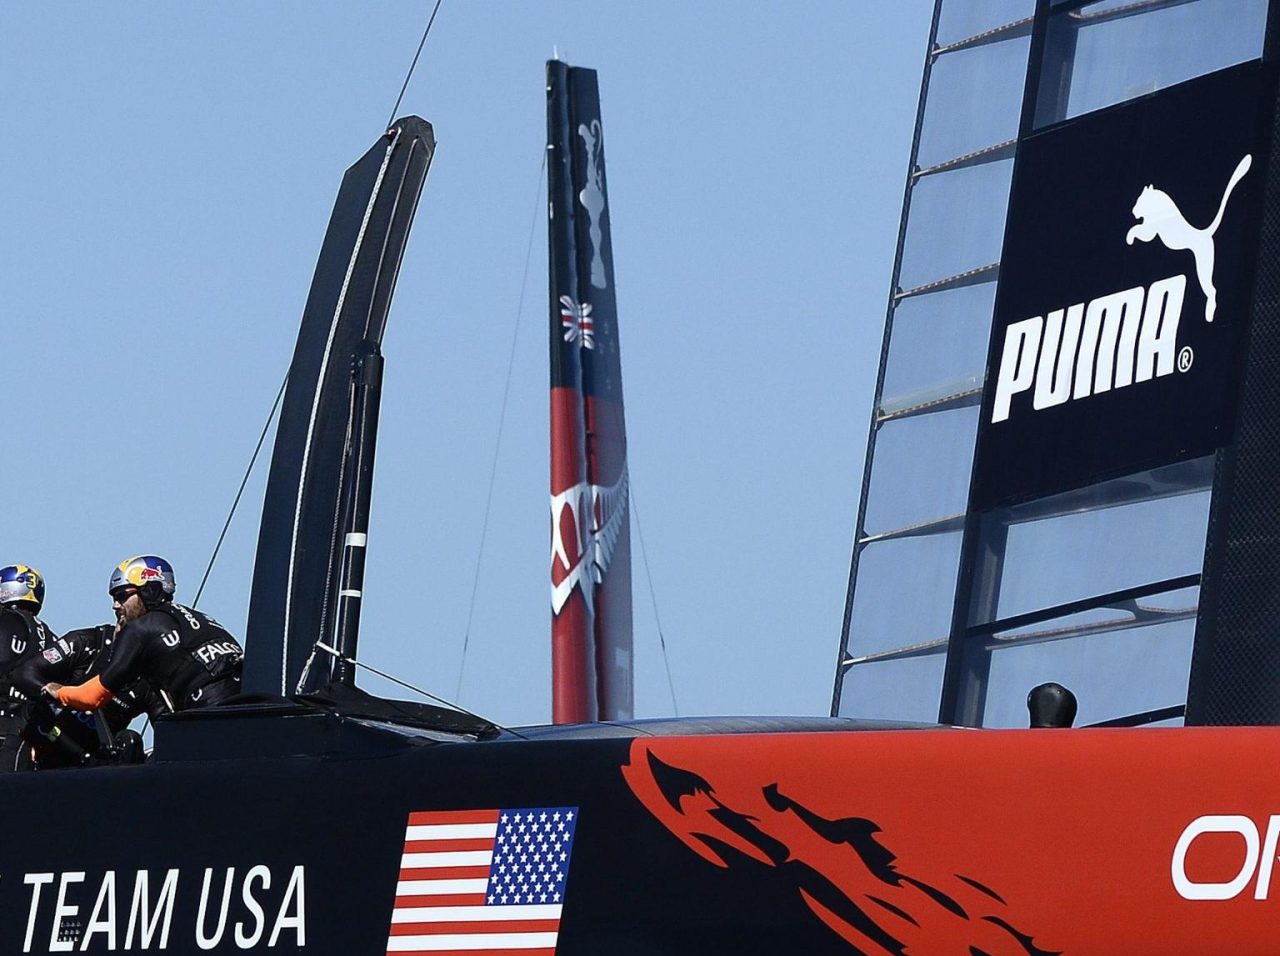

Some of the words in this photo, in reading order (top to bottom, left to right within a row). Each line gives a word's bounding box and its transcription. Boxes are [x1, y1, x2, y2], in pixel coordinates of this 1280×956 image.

[991, 273, 1188, 424] PUMA
[23, 868, 179, 953] TEAM
[195, 865, 307, 950] USA
